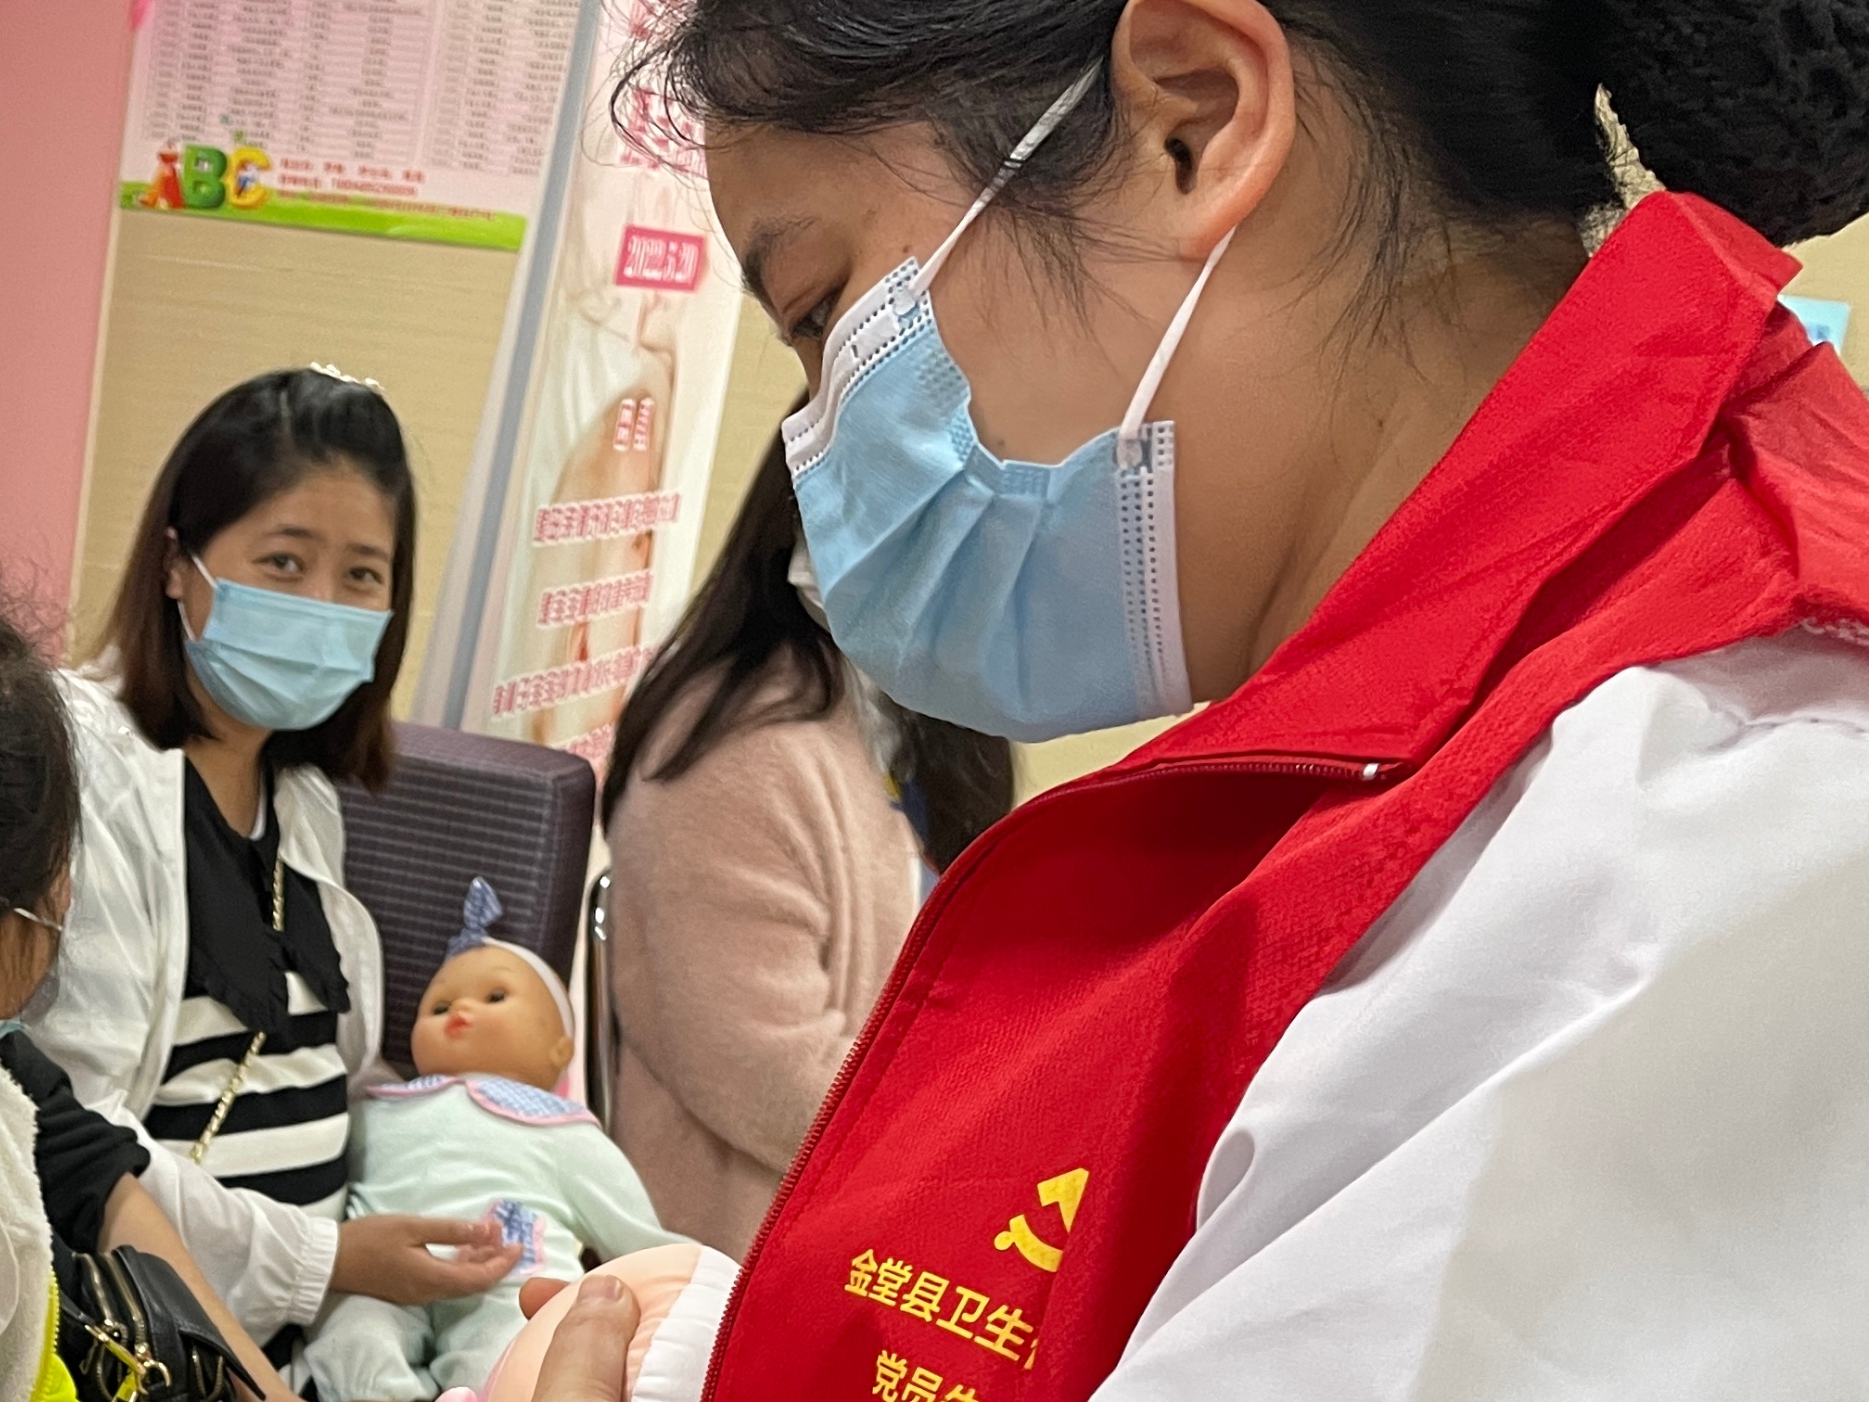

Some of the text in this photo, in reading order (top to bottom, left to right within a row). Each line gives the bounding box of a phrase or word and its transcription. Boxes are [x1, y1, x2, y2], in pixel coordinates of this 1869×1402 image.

[844, 1248, 1042, 1370] 金堂县卫生
